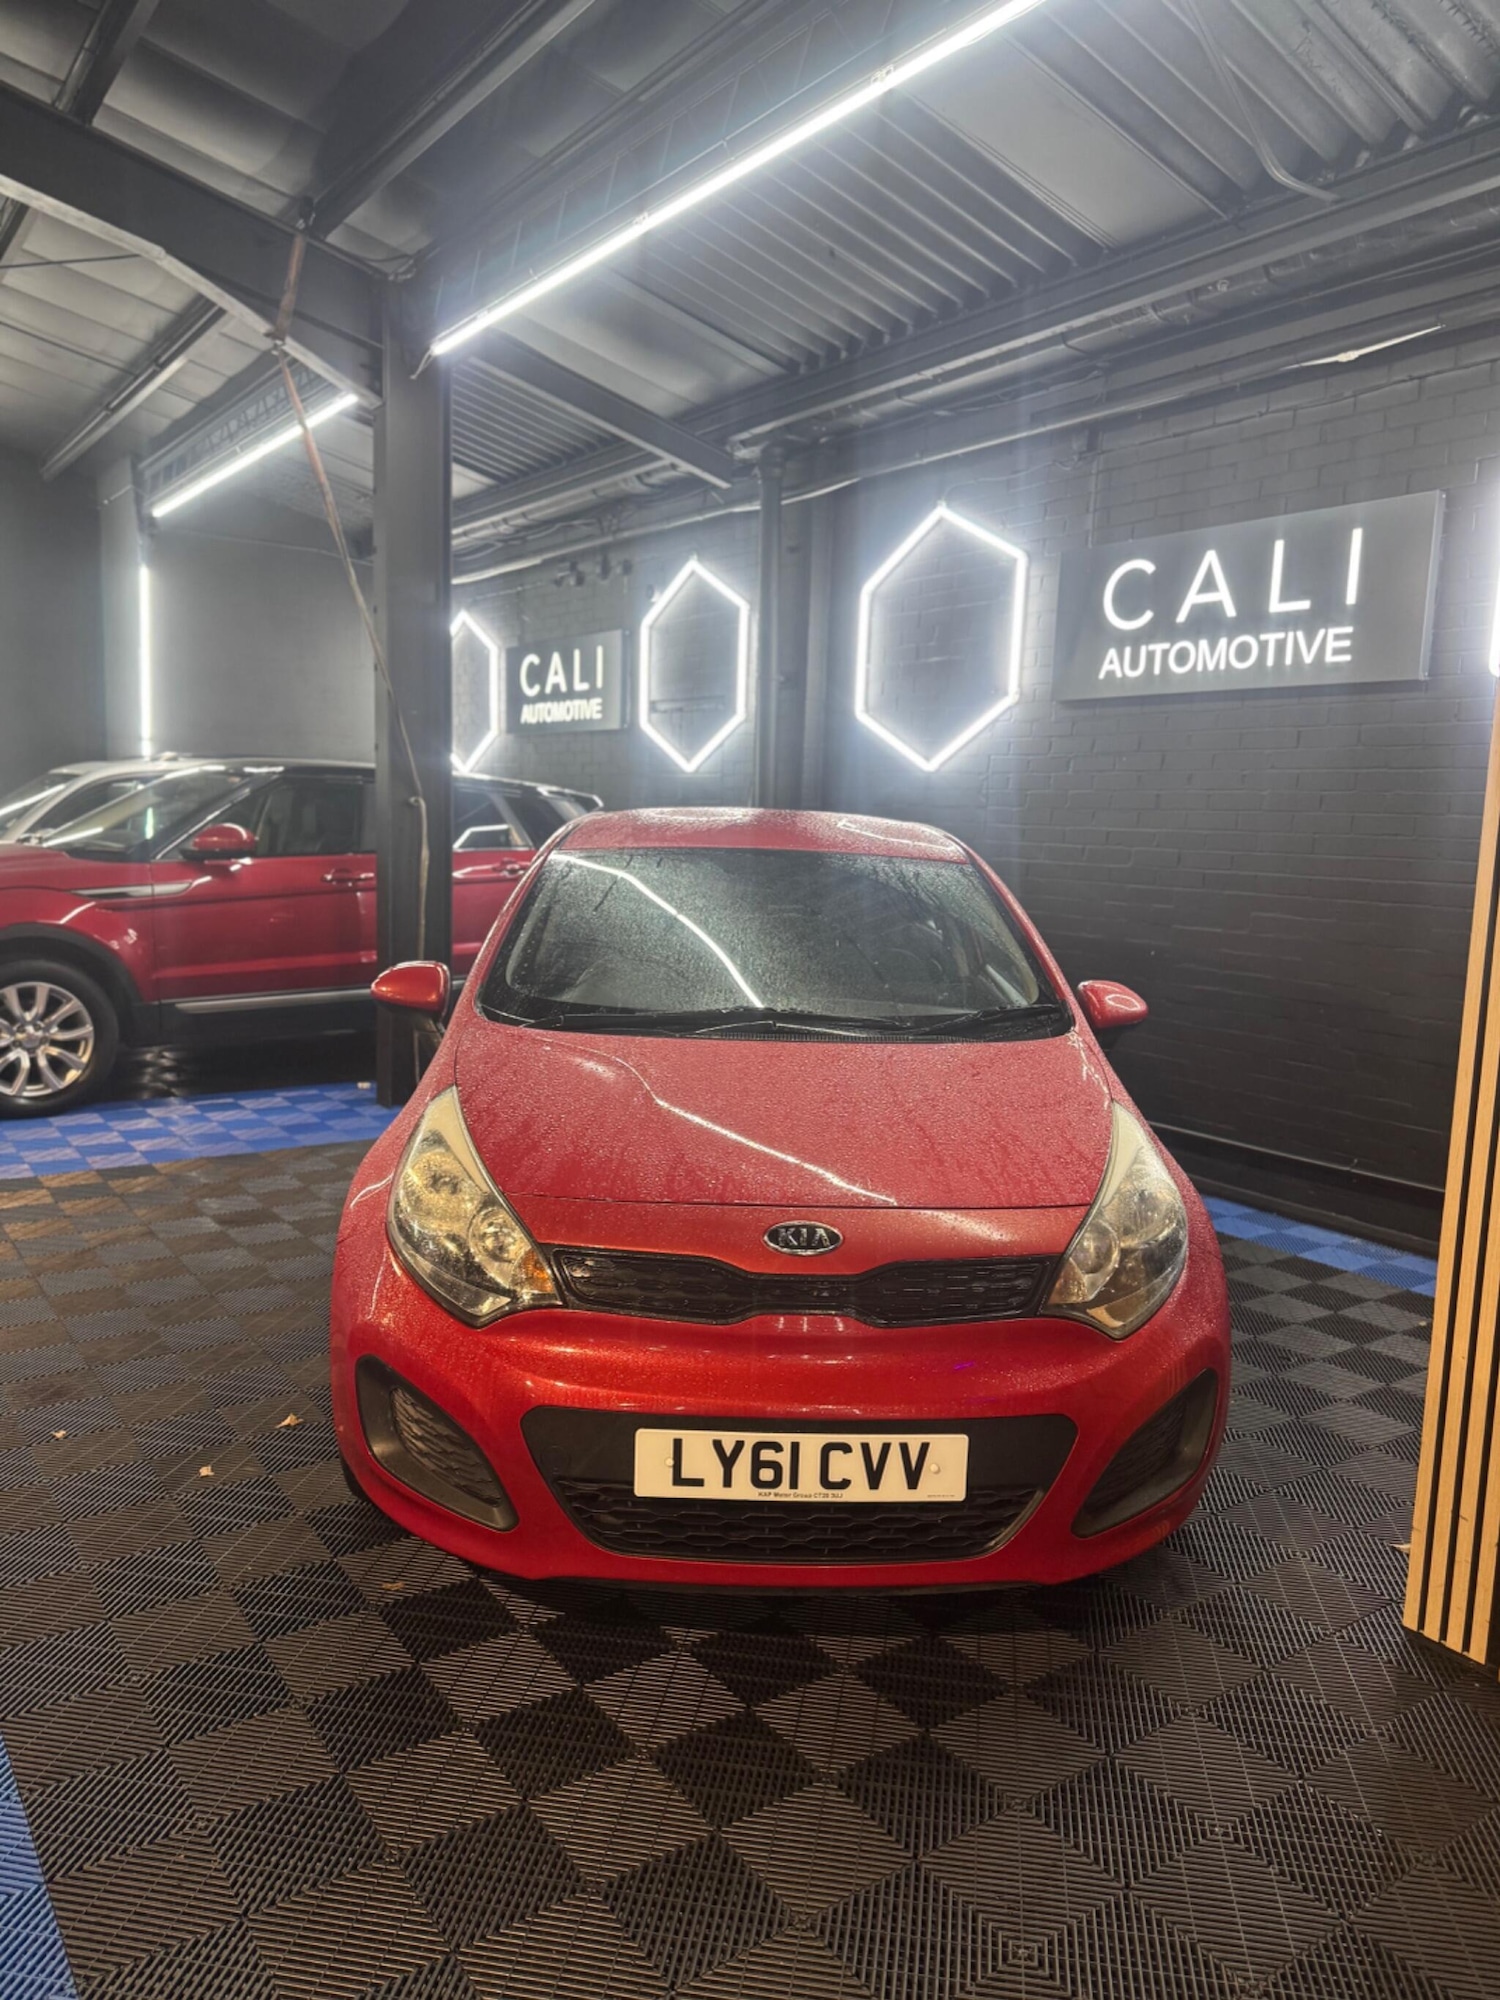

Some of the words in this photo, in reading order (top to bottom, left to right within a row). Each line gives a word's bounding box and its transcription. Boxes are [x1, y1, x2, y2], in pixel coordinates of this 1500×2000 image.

[1102, 527, 1364, 631] CALI
[519, 645, 605, 697] CALI
[1098, 626, 1355, 680] AUTOMOTIVE
[520, 697, 604, 725] AUTOMOTIVE
[776, 1227, 831, 1247] KIA
[671, 1437, 801, 1490] LY61
[819, 1440, 931, 1491] CVV
